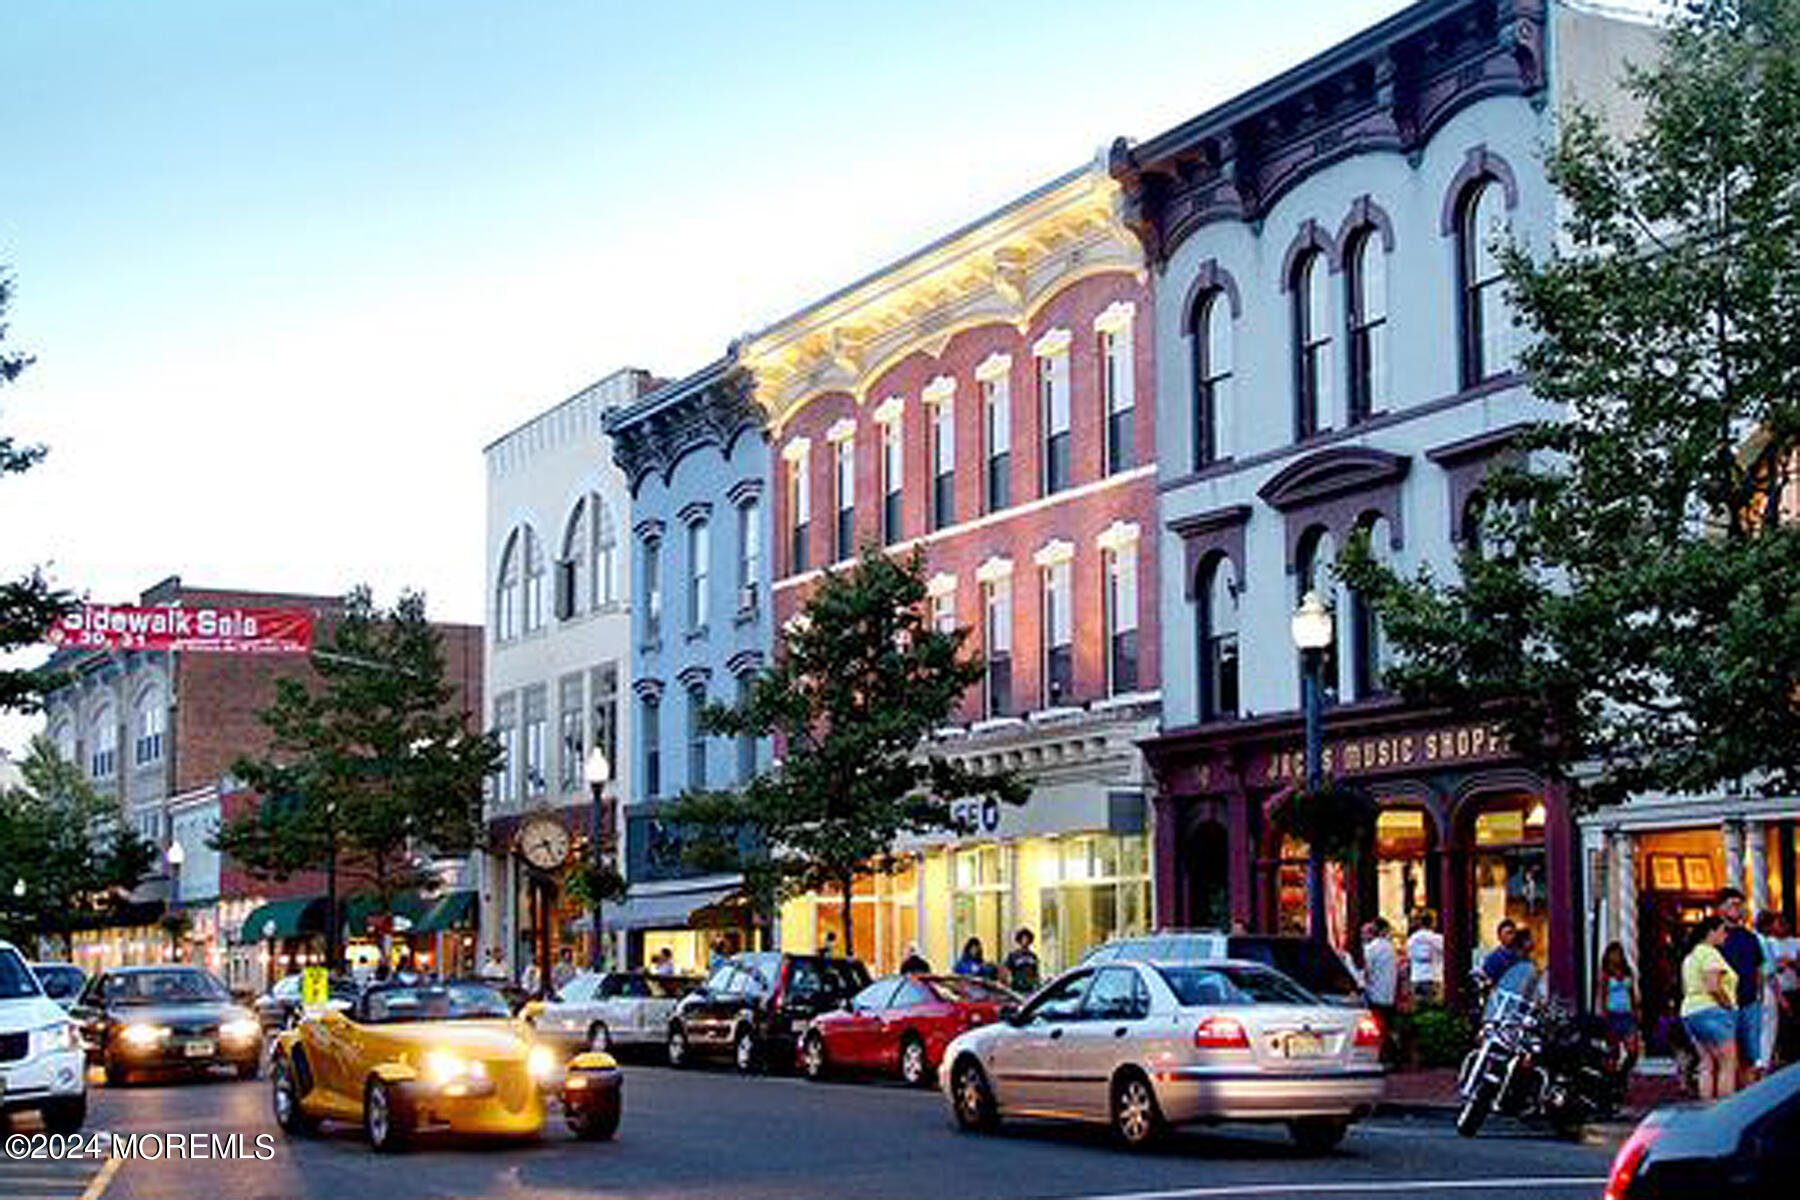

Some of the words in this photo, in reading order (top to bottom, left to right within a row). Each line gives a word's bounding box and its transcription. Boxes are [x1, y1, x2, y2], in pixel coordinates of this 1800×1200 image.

[64, 606, 192, 636] Sidewalk
[197, 608, 258, 637] Sale
[1342, 736, 1414, 771] MUSIC
